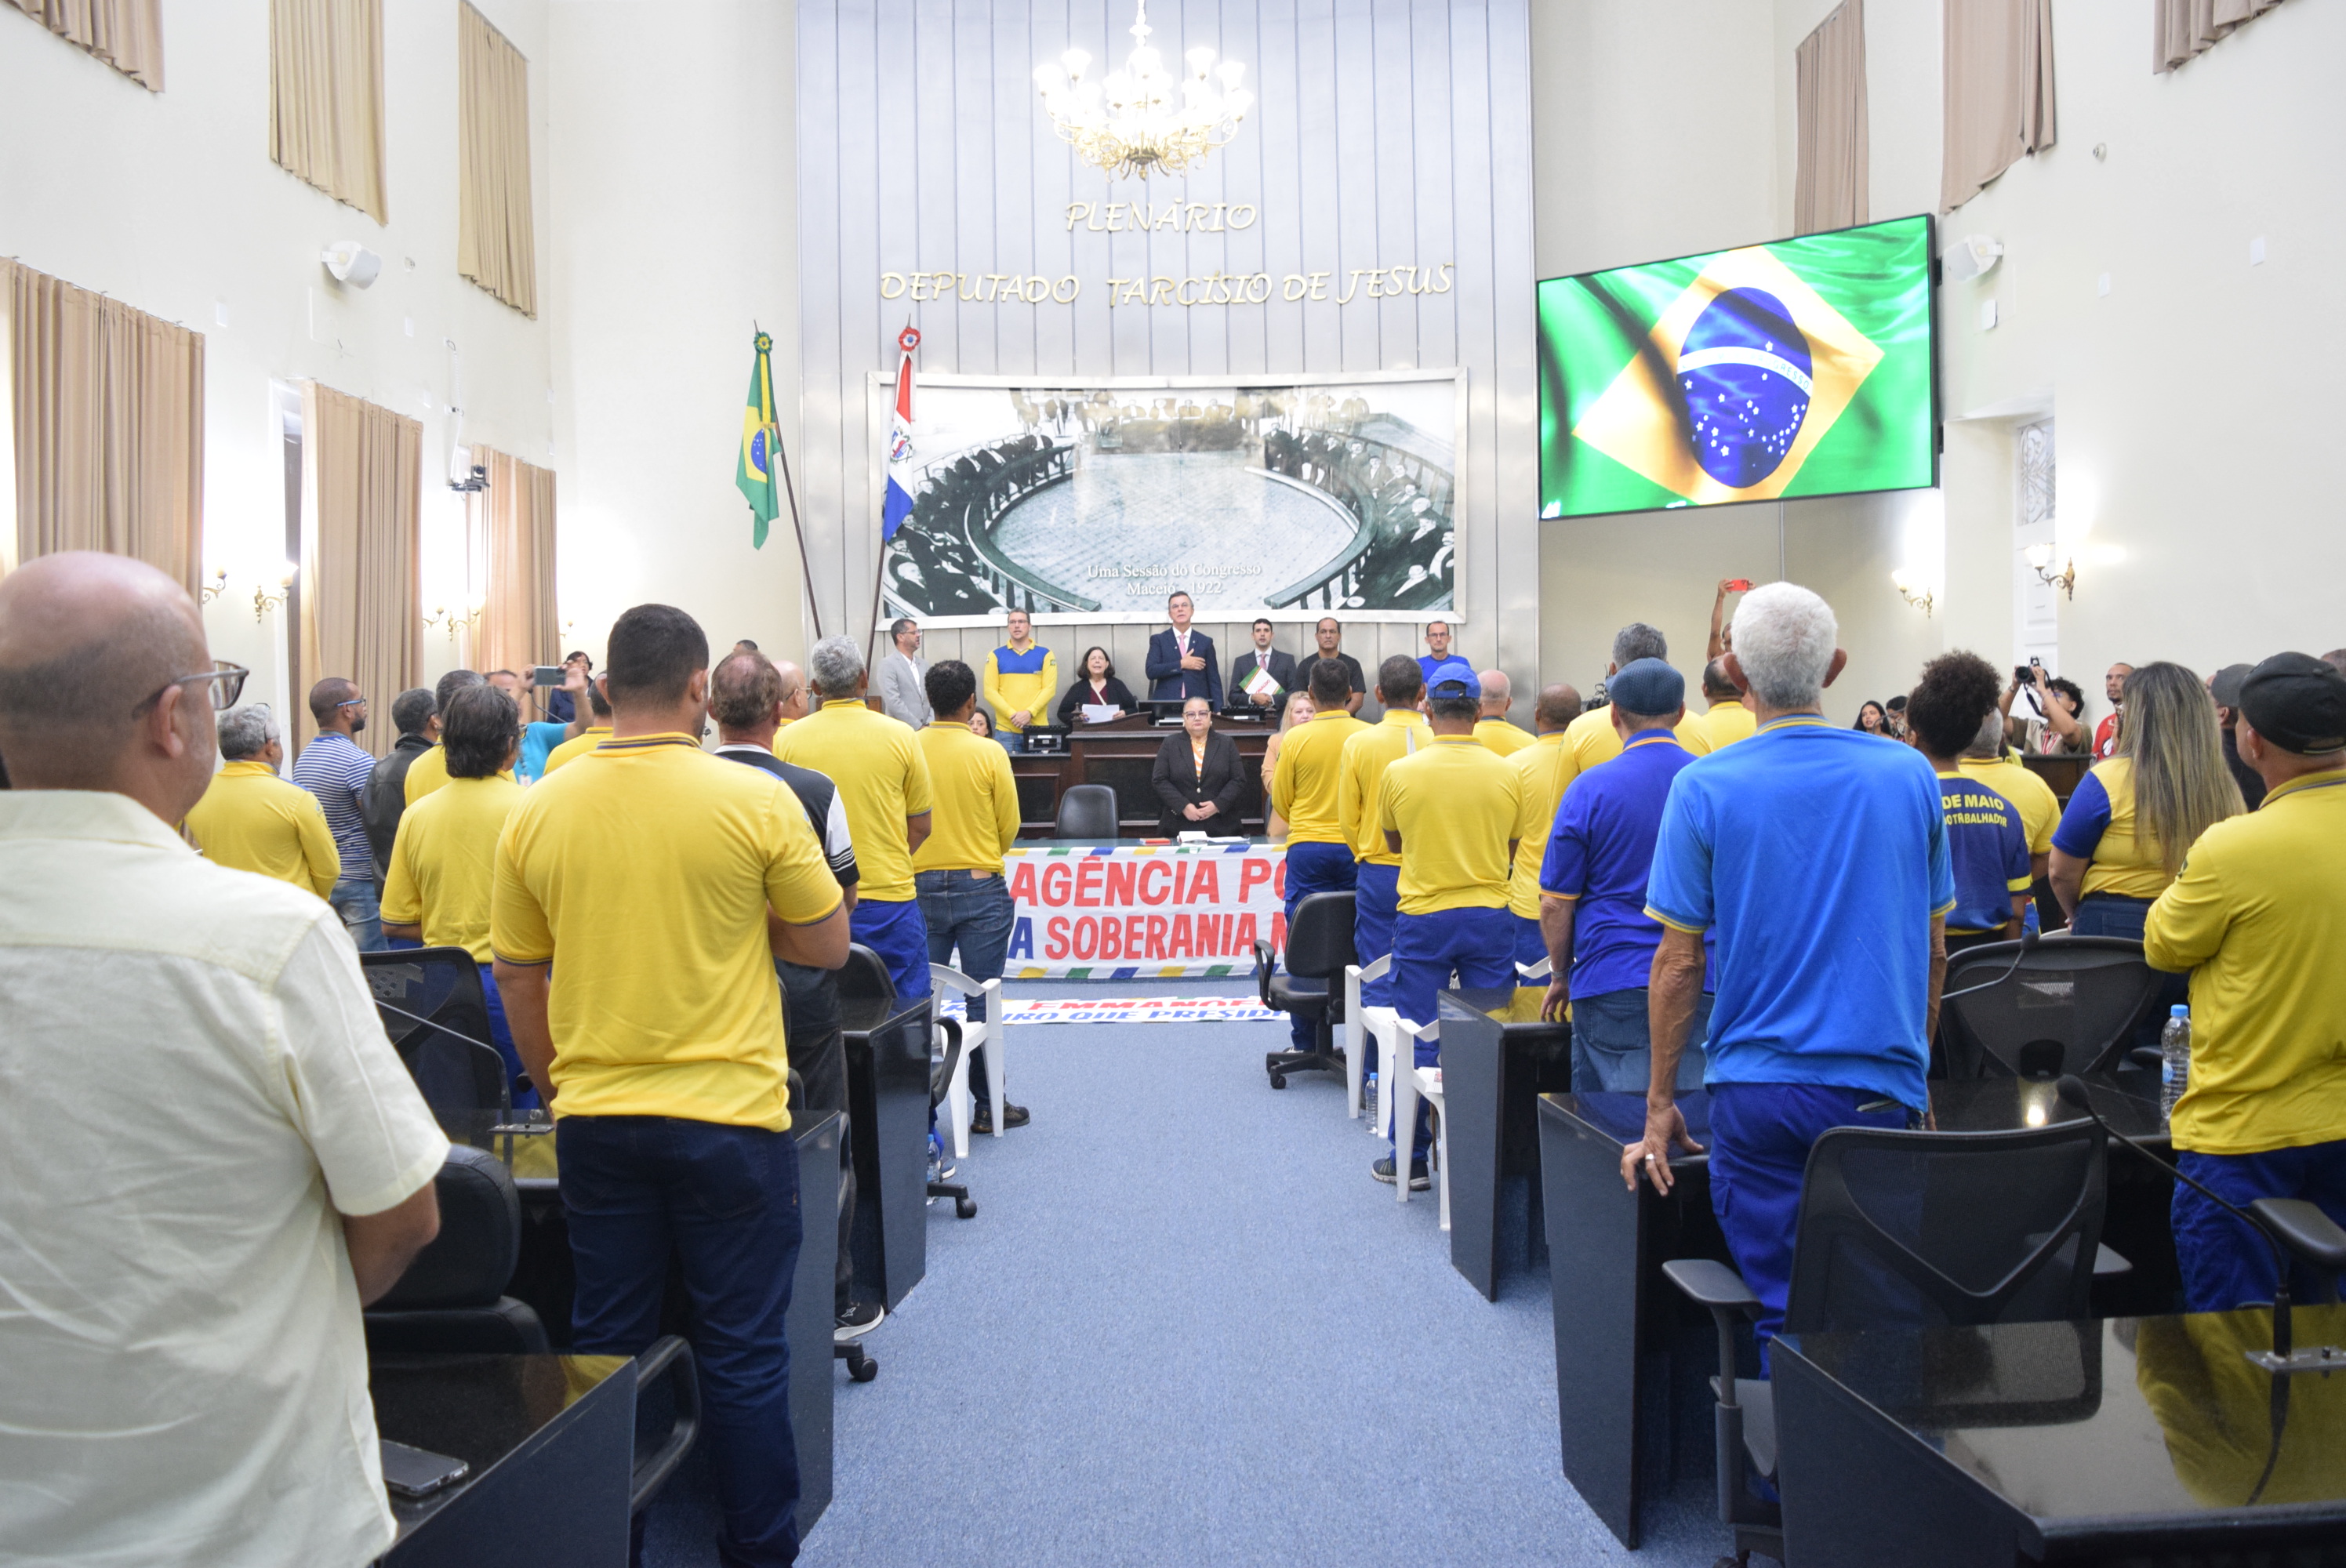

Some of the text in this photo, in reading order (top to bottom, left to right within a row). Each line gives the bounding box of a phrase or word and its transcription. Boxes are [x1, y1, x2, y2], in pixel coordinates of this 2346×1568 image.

[1066, 198, 1257, 232] PLENÁRIO
[880, 262, 1454, 307] DEPUTADO TARCÍSIO DE JESUS
[1088, 563, 1262, 579] Uma Sessão do Congresso
[1128, 582, 1176, 595] Maceió
[1190, 581, 1222, 594] 1922
[1942, 794, 2004, 811] DE MAIO
[1009, 856, 1220, 907] AGÊNCIA
[1045, 913, 1257, 960] SOBERANIA
